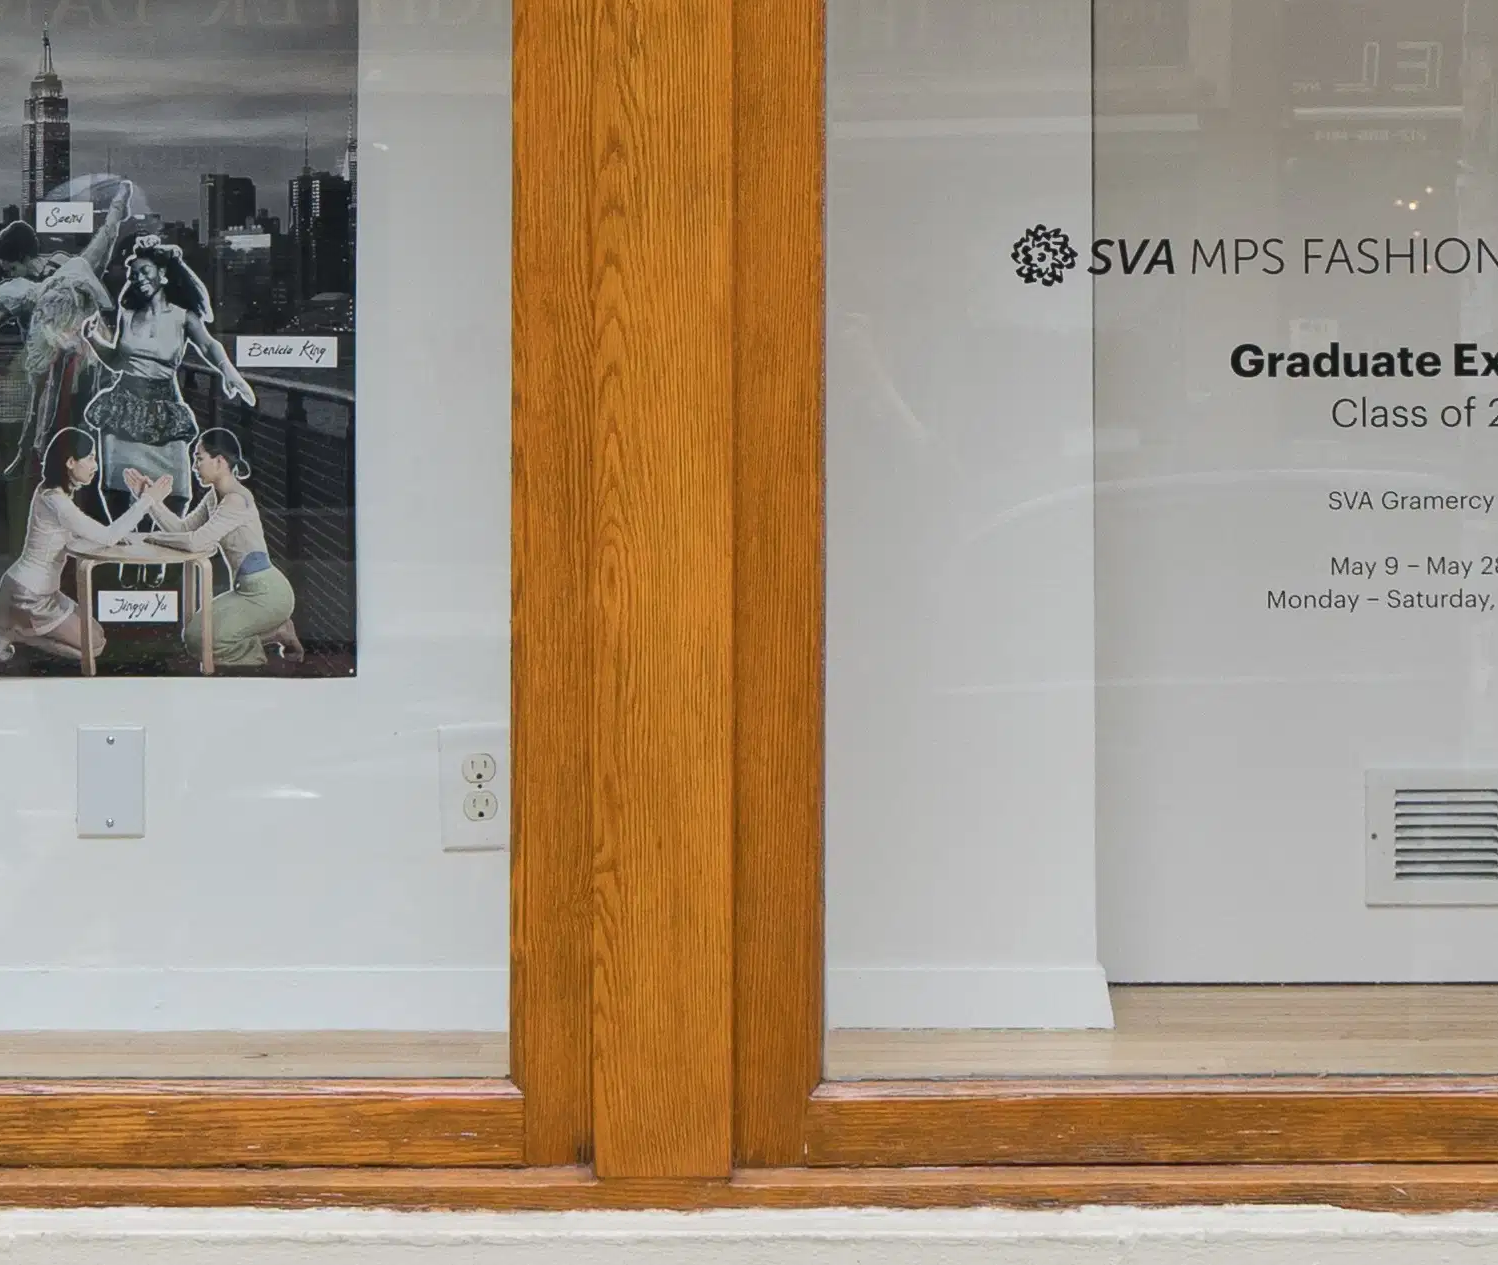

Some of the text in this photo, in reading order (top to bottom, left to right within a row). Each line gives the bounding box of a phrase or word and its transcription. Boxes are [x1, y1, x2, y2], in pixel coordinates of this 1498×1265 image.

[1086, 230, 1175, 280] SVA
[1191, 237, 1285, 275] MPS
[247, 339, 327, 364] Benicia King
[1230, 341, 1442, 378] Graduate
[1331, 396, 1428, 428] Class
[1440, 395, 1477, 428] of
[1328, 490, 1374, 511] SVA
[1381, 490, 1495, 514] Gramercy
[1331, 556, 1377, 580] May
[1384, 556, 1399, 576] 9
[1427, 556, 1473, 580] May
[108, 592, 168, 620] Jingyi Yu
[1267, 588, 1360, 613] Monday
[1387, 587, 1495, 613] Saturday,
